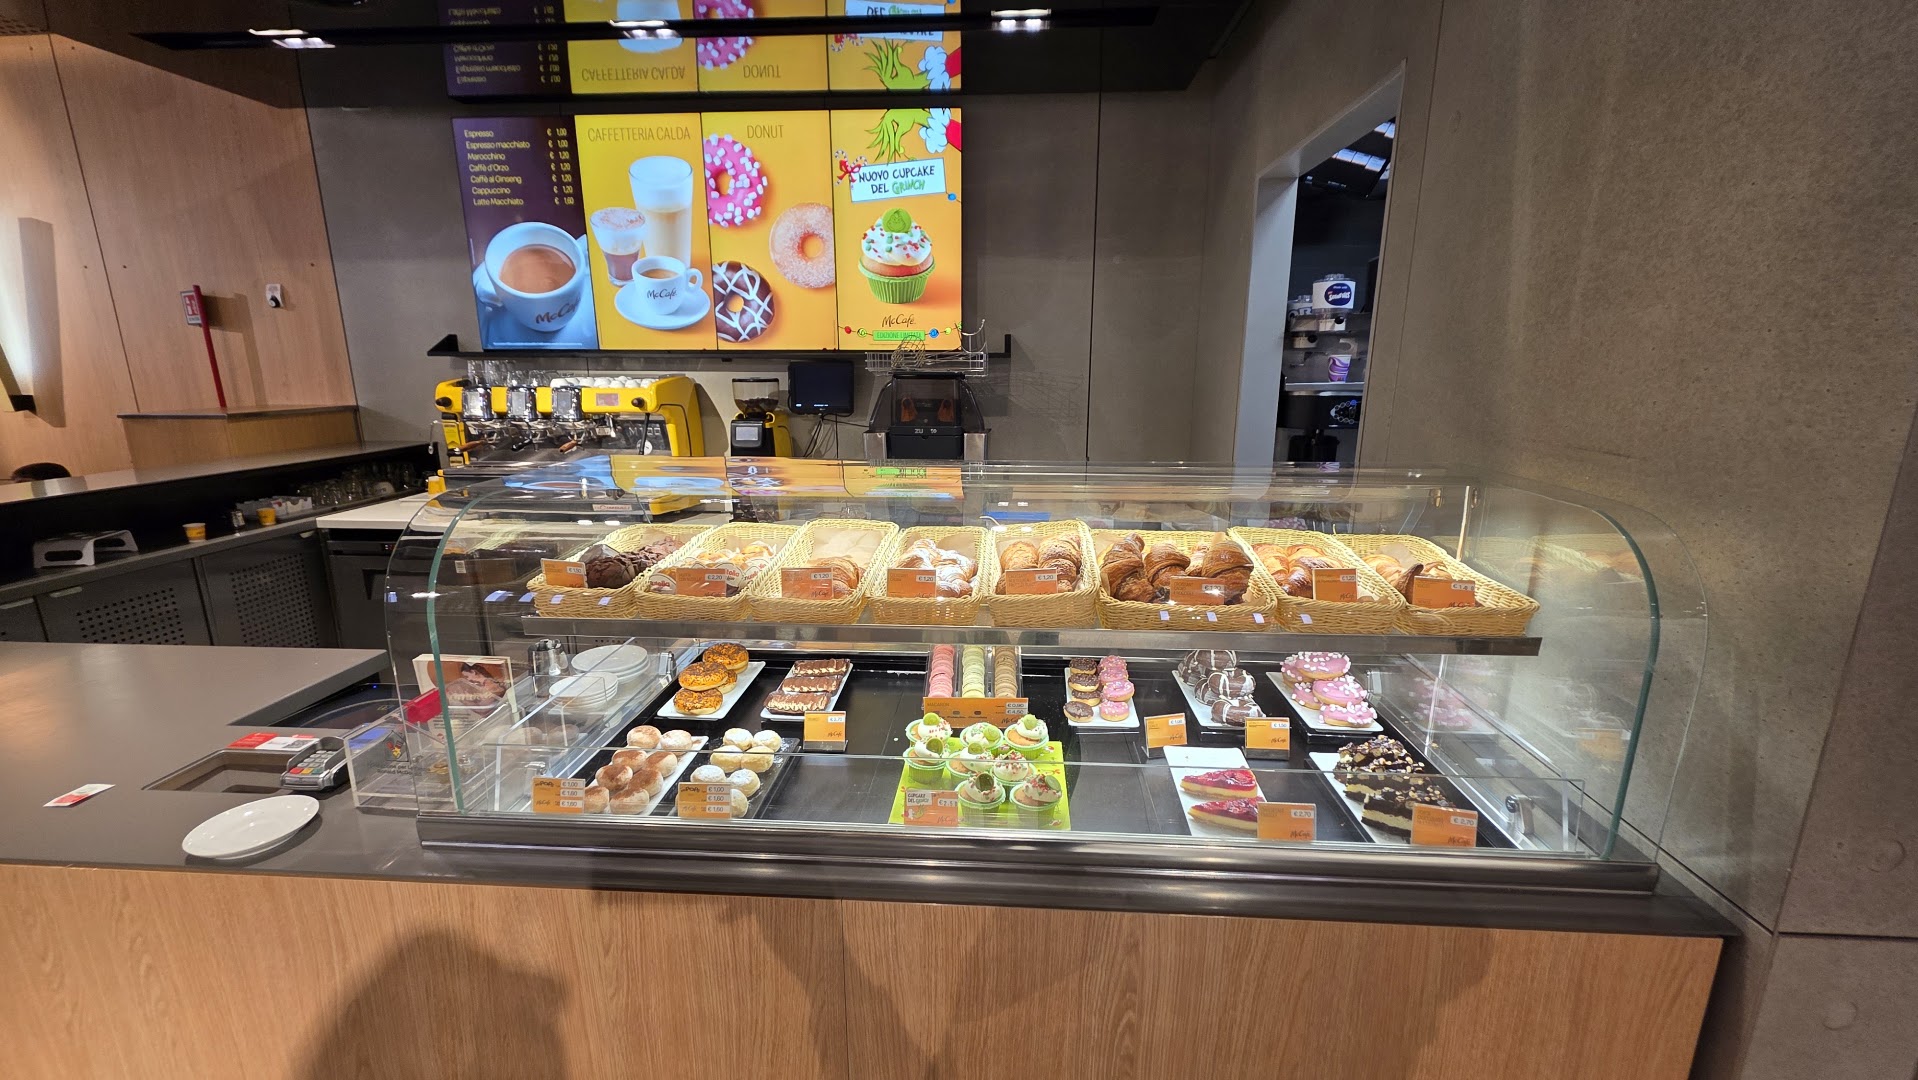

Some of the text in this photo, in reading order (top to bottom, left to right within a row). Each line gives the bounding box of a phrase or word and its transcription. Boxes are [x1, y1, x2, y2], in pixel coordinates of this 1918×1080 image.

[464, 130, 494, 138] Espresso
[588, 126, 690, 142] CAFFETTERIA CALDA
[747, 124, 784, 139] DONUT
[466, 141, 495, 150] Espresso
[495, 176, 522, 184] Ginseng
[859, 165, 935, 183] NUOVO CUPCAKE
[472, 187, 510, 195] Cappuccino
[871, 180, 925, 195] DEL GRINCH
[882, 314, 916, 327] McCafé
